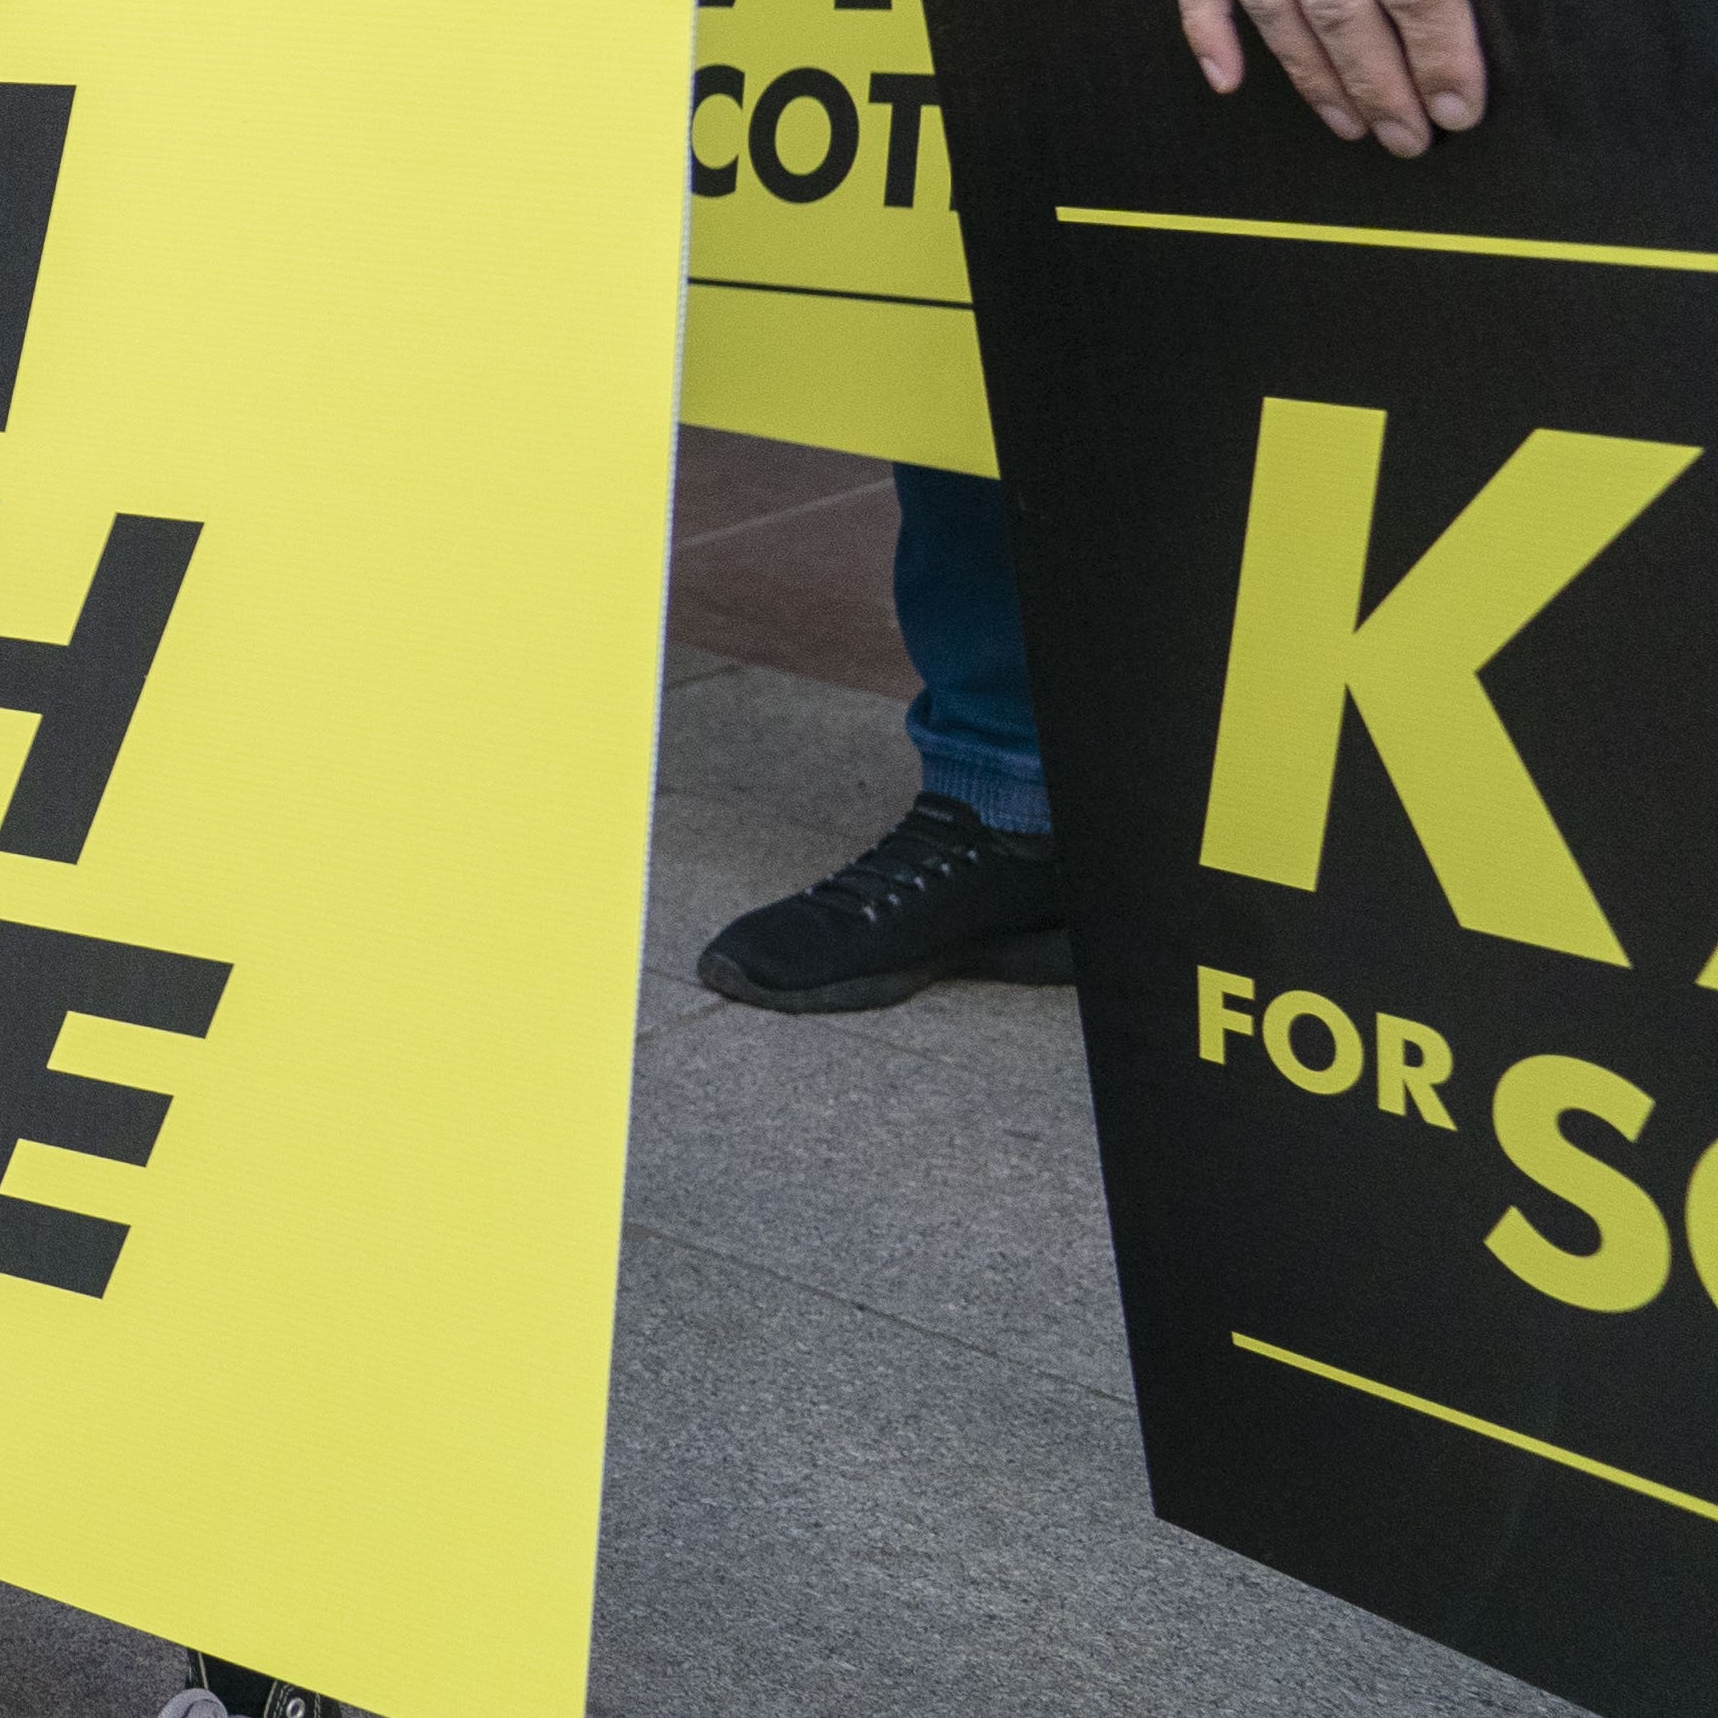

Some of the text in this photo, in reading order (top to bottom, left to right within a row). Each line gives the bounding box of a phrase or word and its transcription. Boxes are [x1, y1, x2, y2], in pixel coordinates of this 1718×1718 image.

[1199, 396, 1718, 988] K
[1197, 965, 1718, 1312] FOR S
